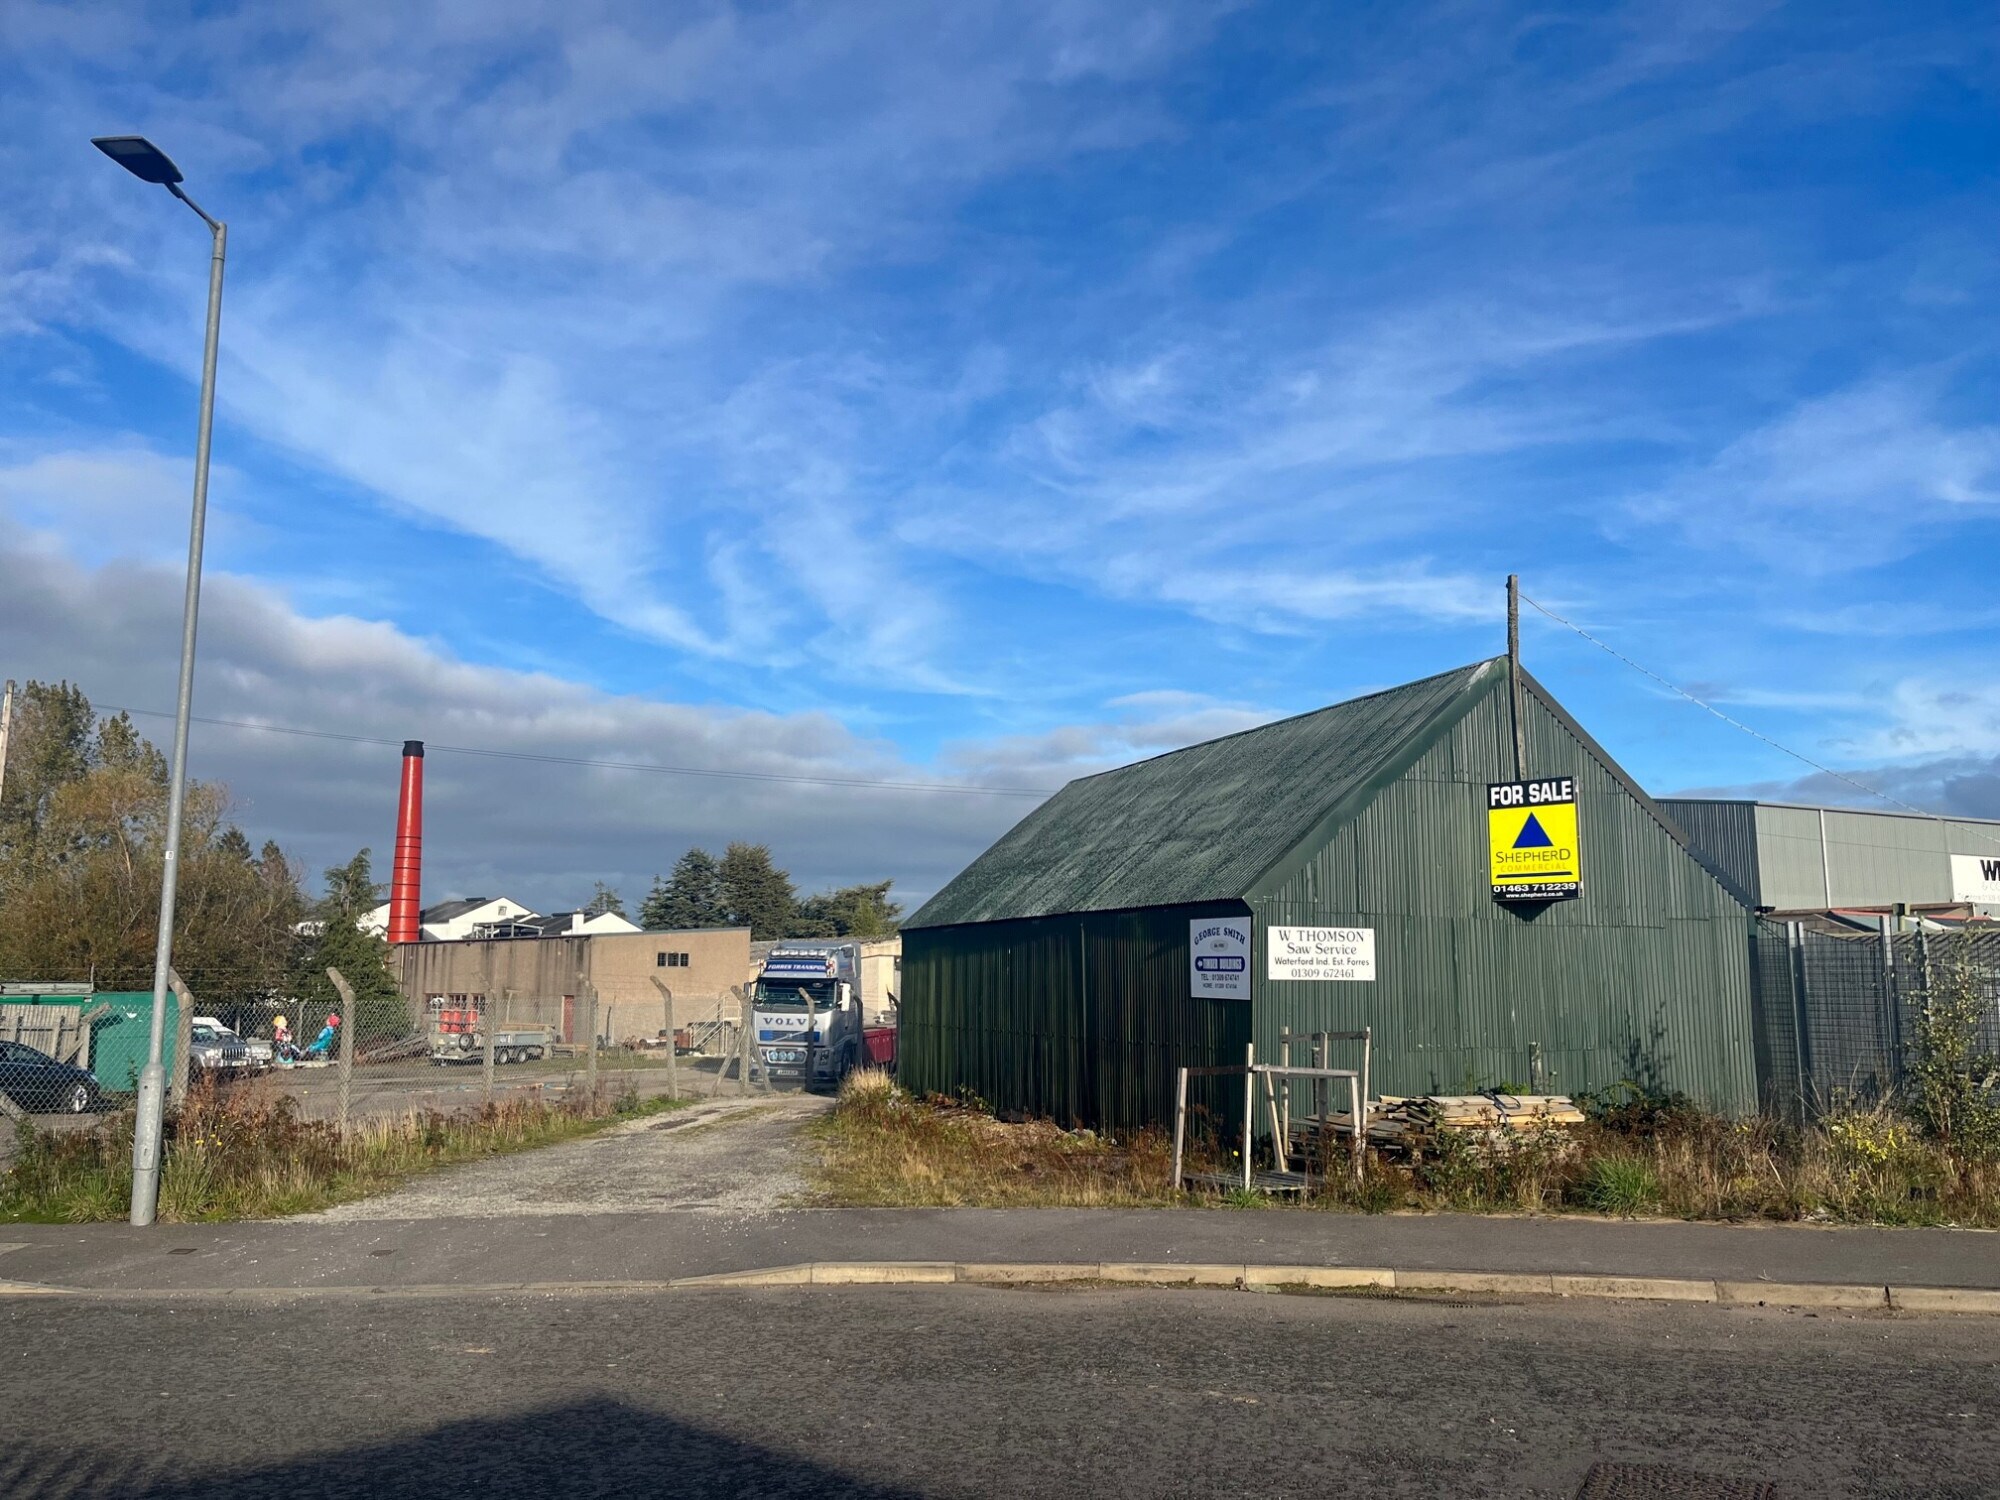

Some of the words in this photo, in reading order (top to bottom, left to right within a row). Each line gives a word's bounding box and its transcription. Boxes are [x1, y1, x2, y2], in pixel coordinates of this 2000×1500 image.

[1490, 785, 1523, 806] FOR
[1529, 780, 1572, 803] SALE
[1495, 848, 1571, 864] SHEPHERD
[1500, 863, 1567, 873] COMMERCIAL
[1493, 884, 1529, 893] 01463
[1531, 882, 1577, 891] 712239
[1194, 926, 1221, 946] GEORGE
[1223, 927, 1246, 945] SMITH
[1278, 930, 1291, 941] W
[1296, 930, 1364, 942] THOMSON
[1287, 942, 1311, 954] Saw
[1315, 943, 1357, 955] Service
[1274, 956, 1314, 966] Waterford
[1315, 957, 1330, 966] Ind.
[1346, 957, 1370, 966] Forres
[1291, 968, 1320, 978] 01309
[1323, 968, 1355, 978] 672461
